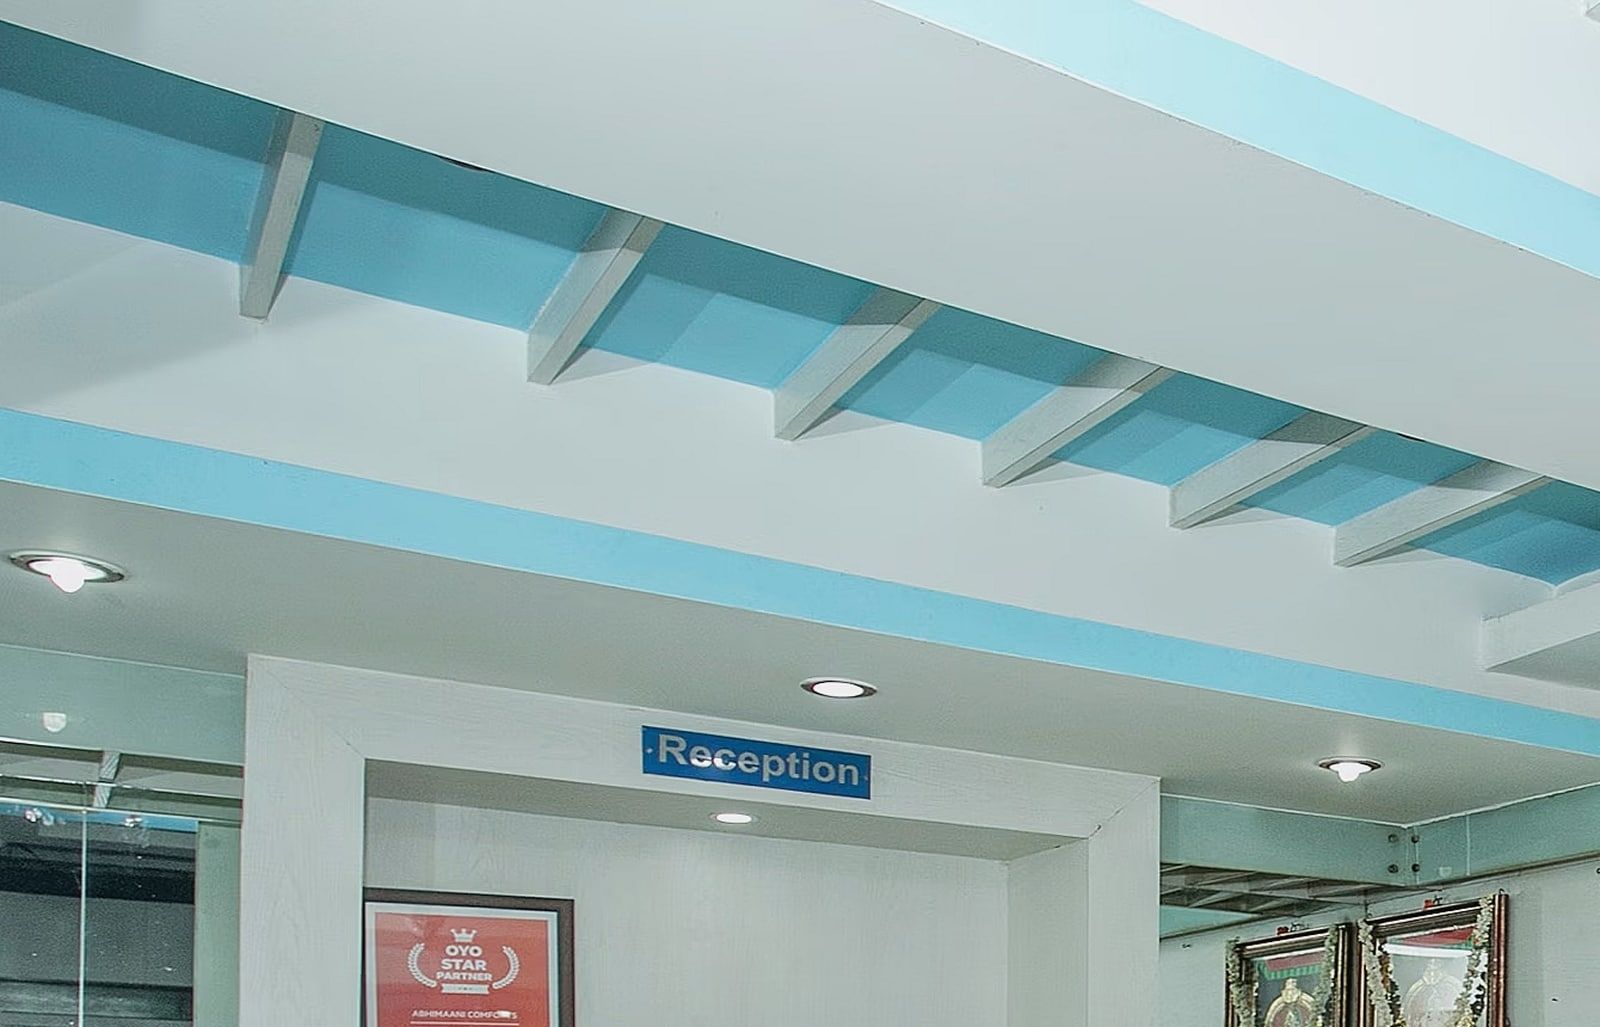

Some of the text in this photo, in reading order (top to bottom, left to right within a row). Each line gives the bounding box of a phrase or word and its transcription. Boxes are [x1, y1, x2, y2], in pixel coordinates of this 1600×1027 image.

[658, 733, 859, 786] Reception
[445, 945, 483, 957] OYO
[441, 958, 487, 971] STAR
[436, 971, 493, 981] PARTNER
